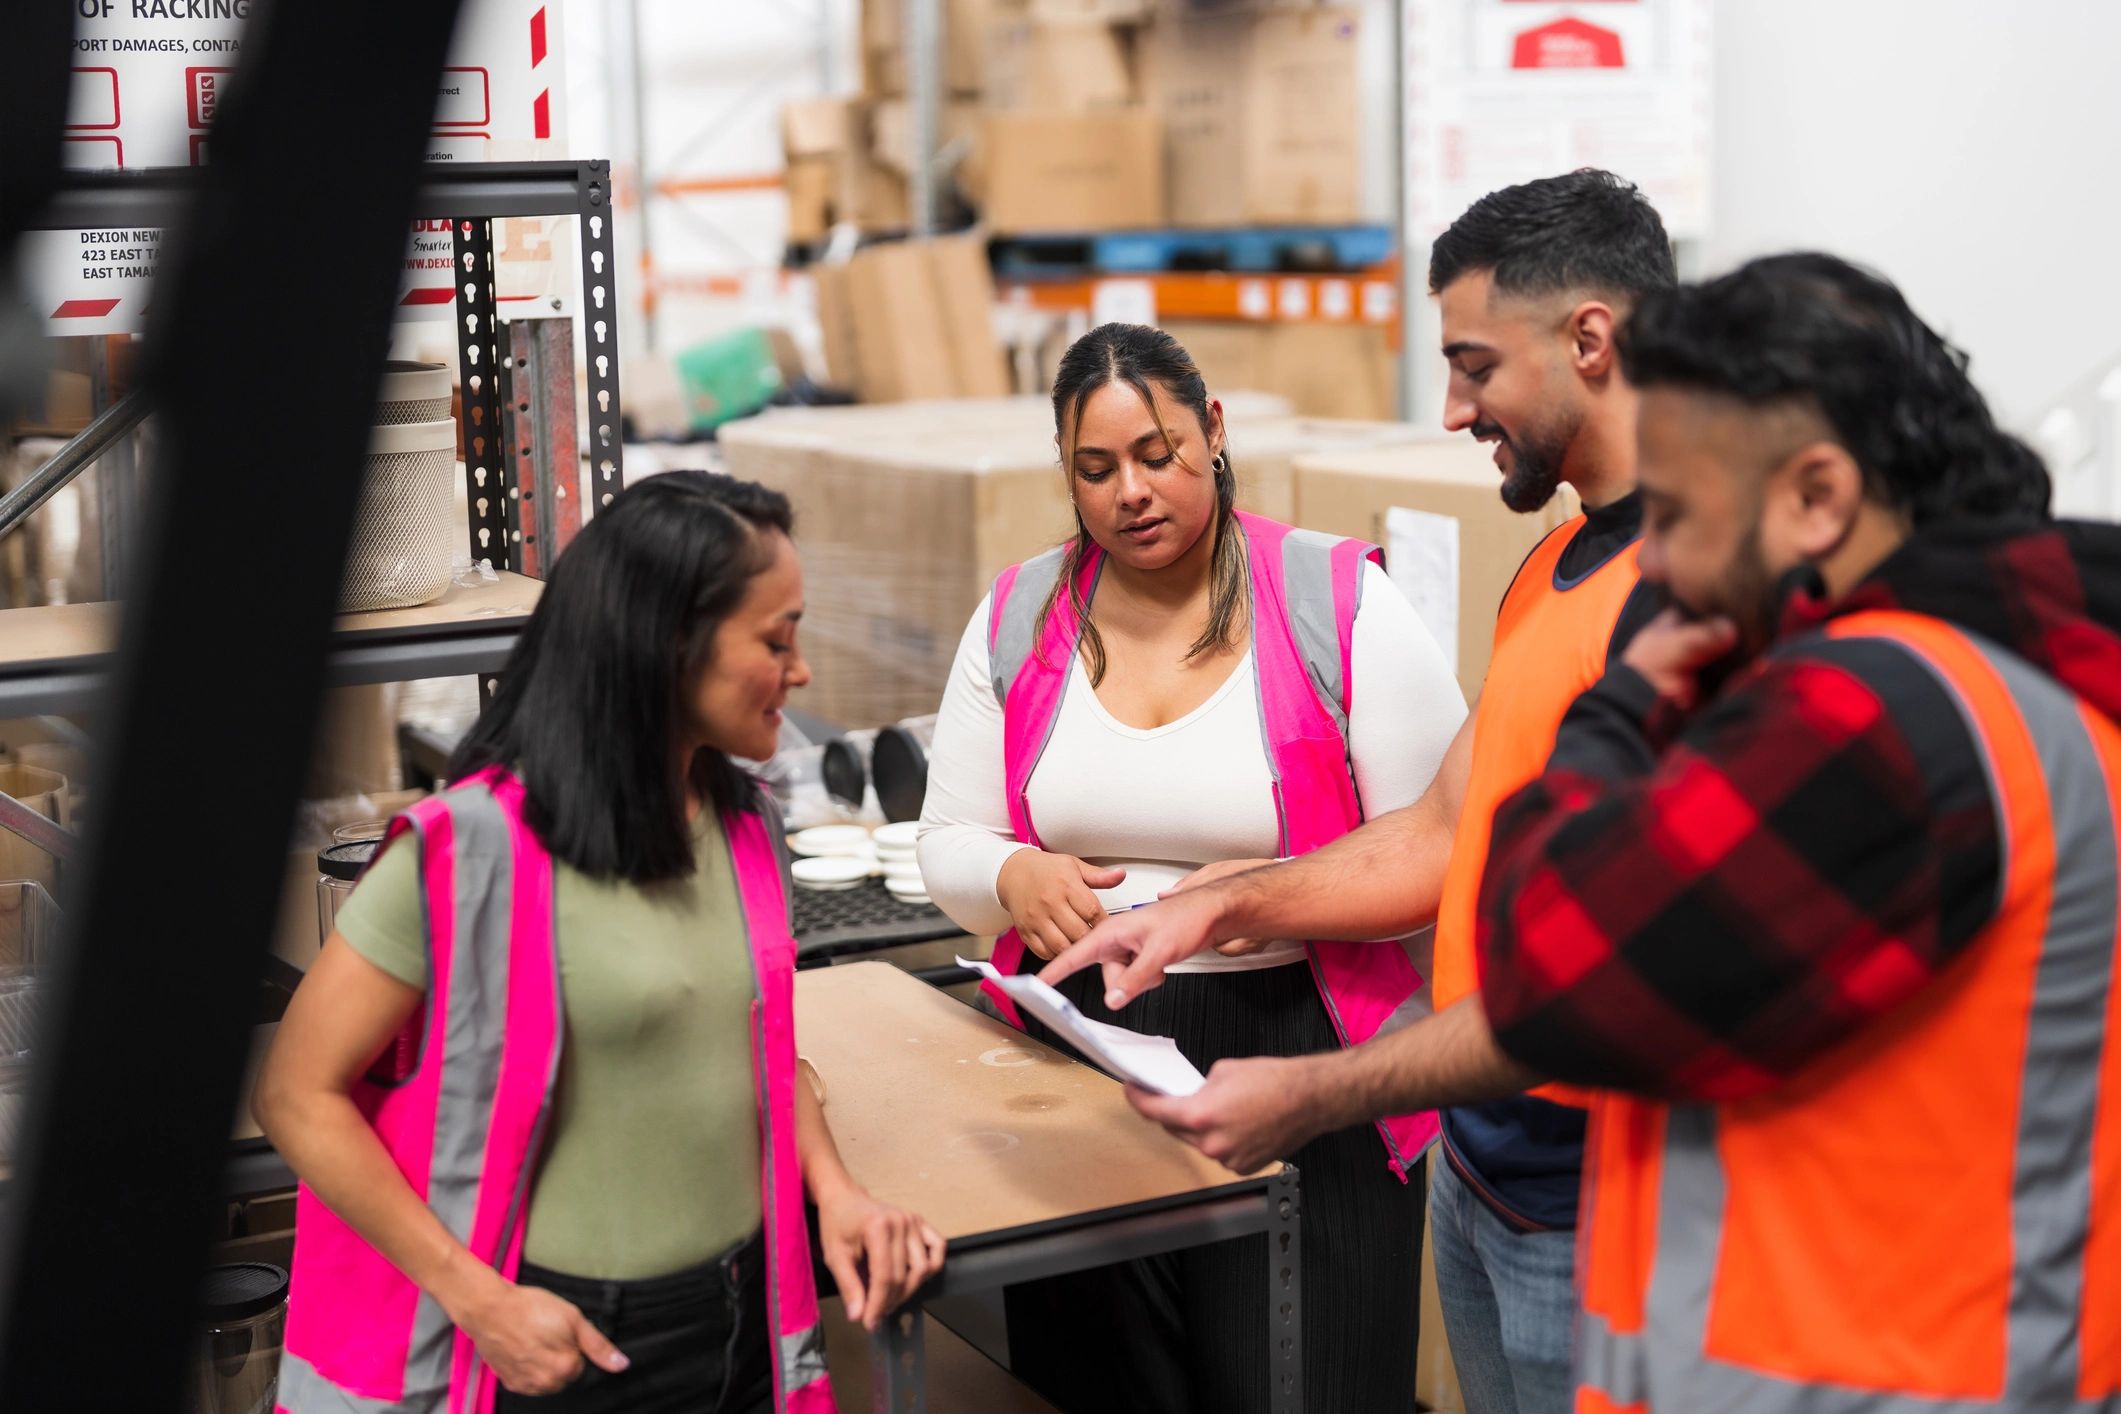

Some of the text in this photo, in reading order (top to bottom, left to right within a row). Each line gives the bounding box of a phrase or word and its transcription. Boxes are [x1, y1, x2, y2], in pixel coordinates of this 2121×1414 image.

[79, 0, 250, 19] OF RACKING
[72, 39, 241, 53] PORT DAMAGES, CONTA
[80, 230, 160, 243] DEXION NEW
[414, 237, 452, 252] Smarter
[81, 250, 106, 261] 423
[110, 248, 142, 260] EAST
[83, 267, 113, 279] EAST
